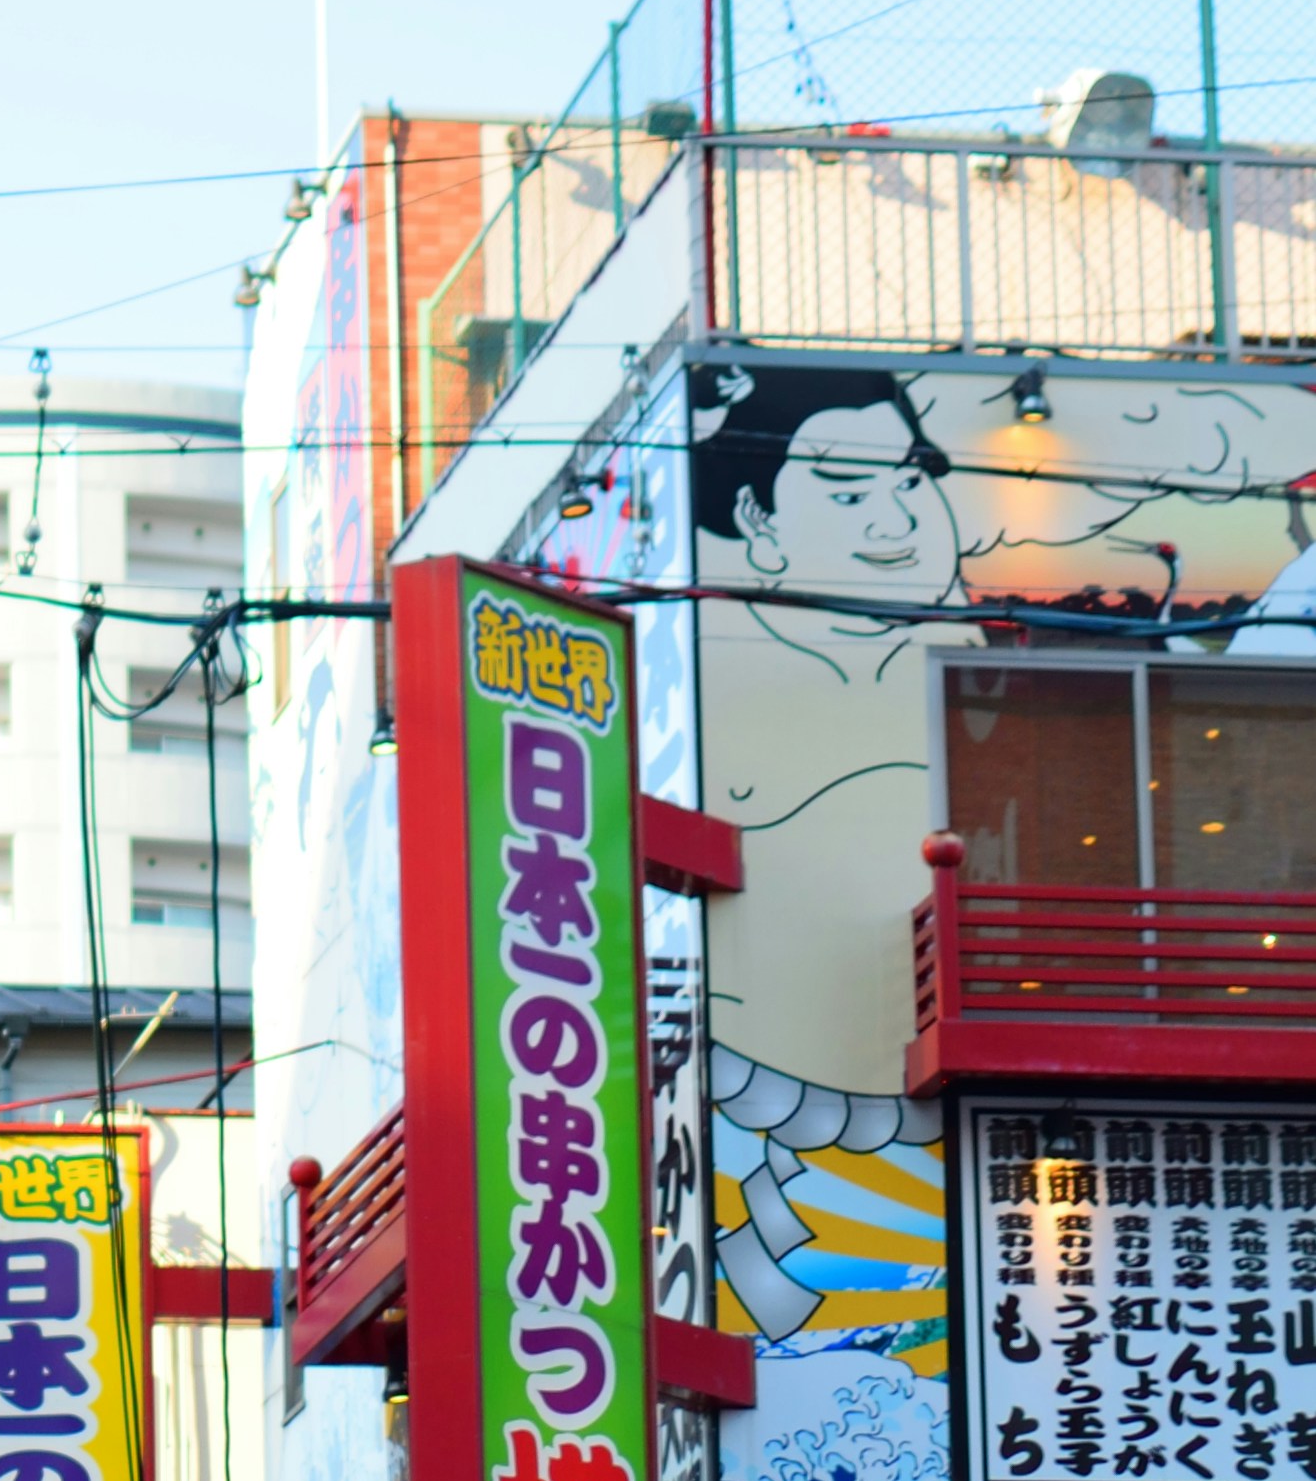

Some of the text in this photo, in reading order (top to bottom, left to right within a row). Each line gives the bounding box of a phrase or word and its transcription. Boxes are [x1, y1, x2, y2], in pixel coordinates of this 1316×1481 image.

[473, 604, 618, 731] 新世界
[503, 722, 610, 1419] 日本一の串かつ
[993, 1293, 1044, 1477] もち
[1051, 1293, 1110, 1477] うずら玉子
[1108, 1295, 1168, 1477] 紅しょうが
[1165, 1299, 1222, 1481] にんにく
[1225, 1298, 1286, 1481] 玉ねぎ
